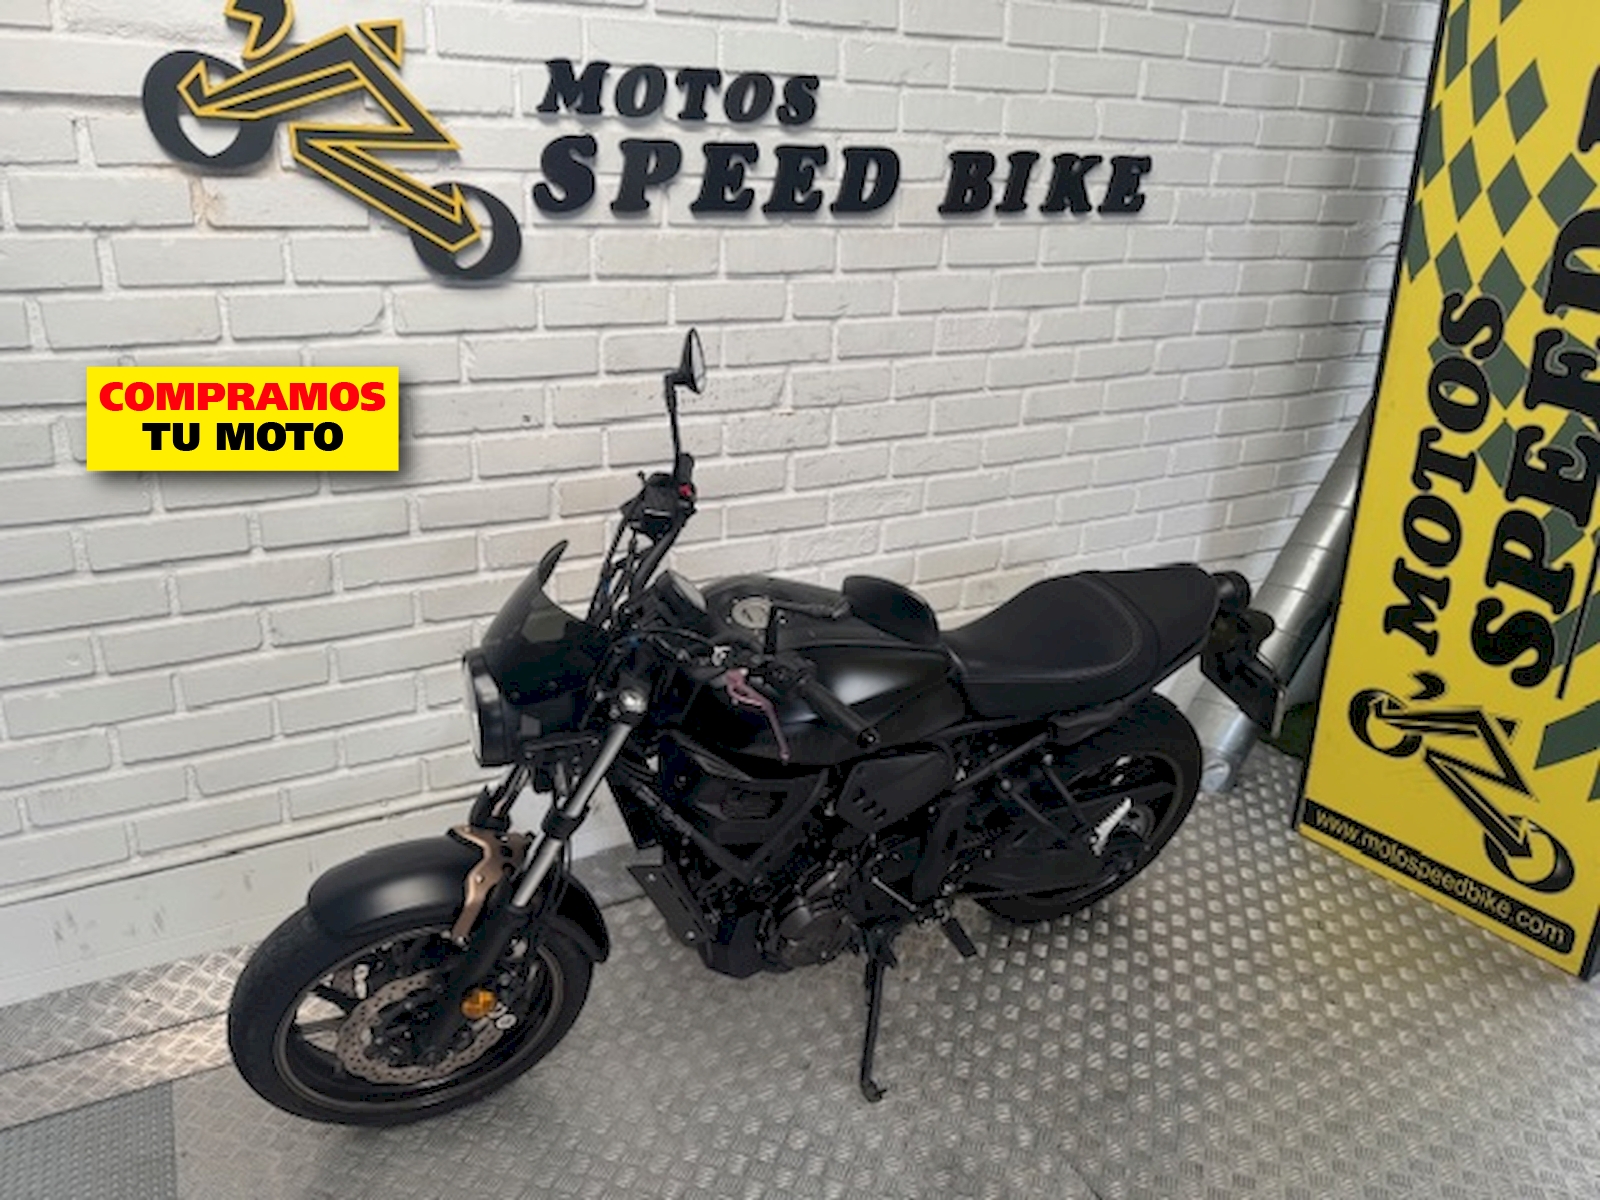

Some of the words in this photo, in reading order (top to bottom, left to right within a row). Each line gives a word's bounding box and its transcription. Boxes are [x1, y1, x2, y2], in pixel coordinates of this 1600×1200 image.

[537, 59, 819, 126] MOTOS
[533, 134, 900, 216] SPEED
[938, 151, 1152, 215] BIKE
[1384, 292, 1505, 656] MOTOS
[1314, 808, 1568, 946] www.motospeedbike.com
